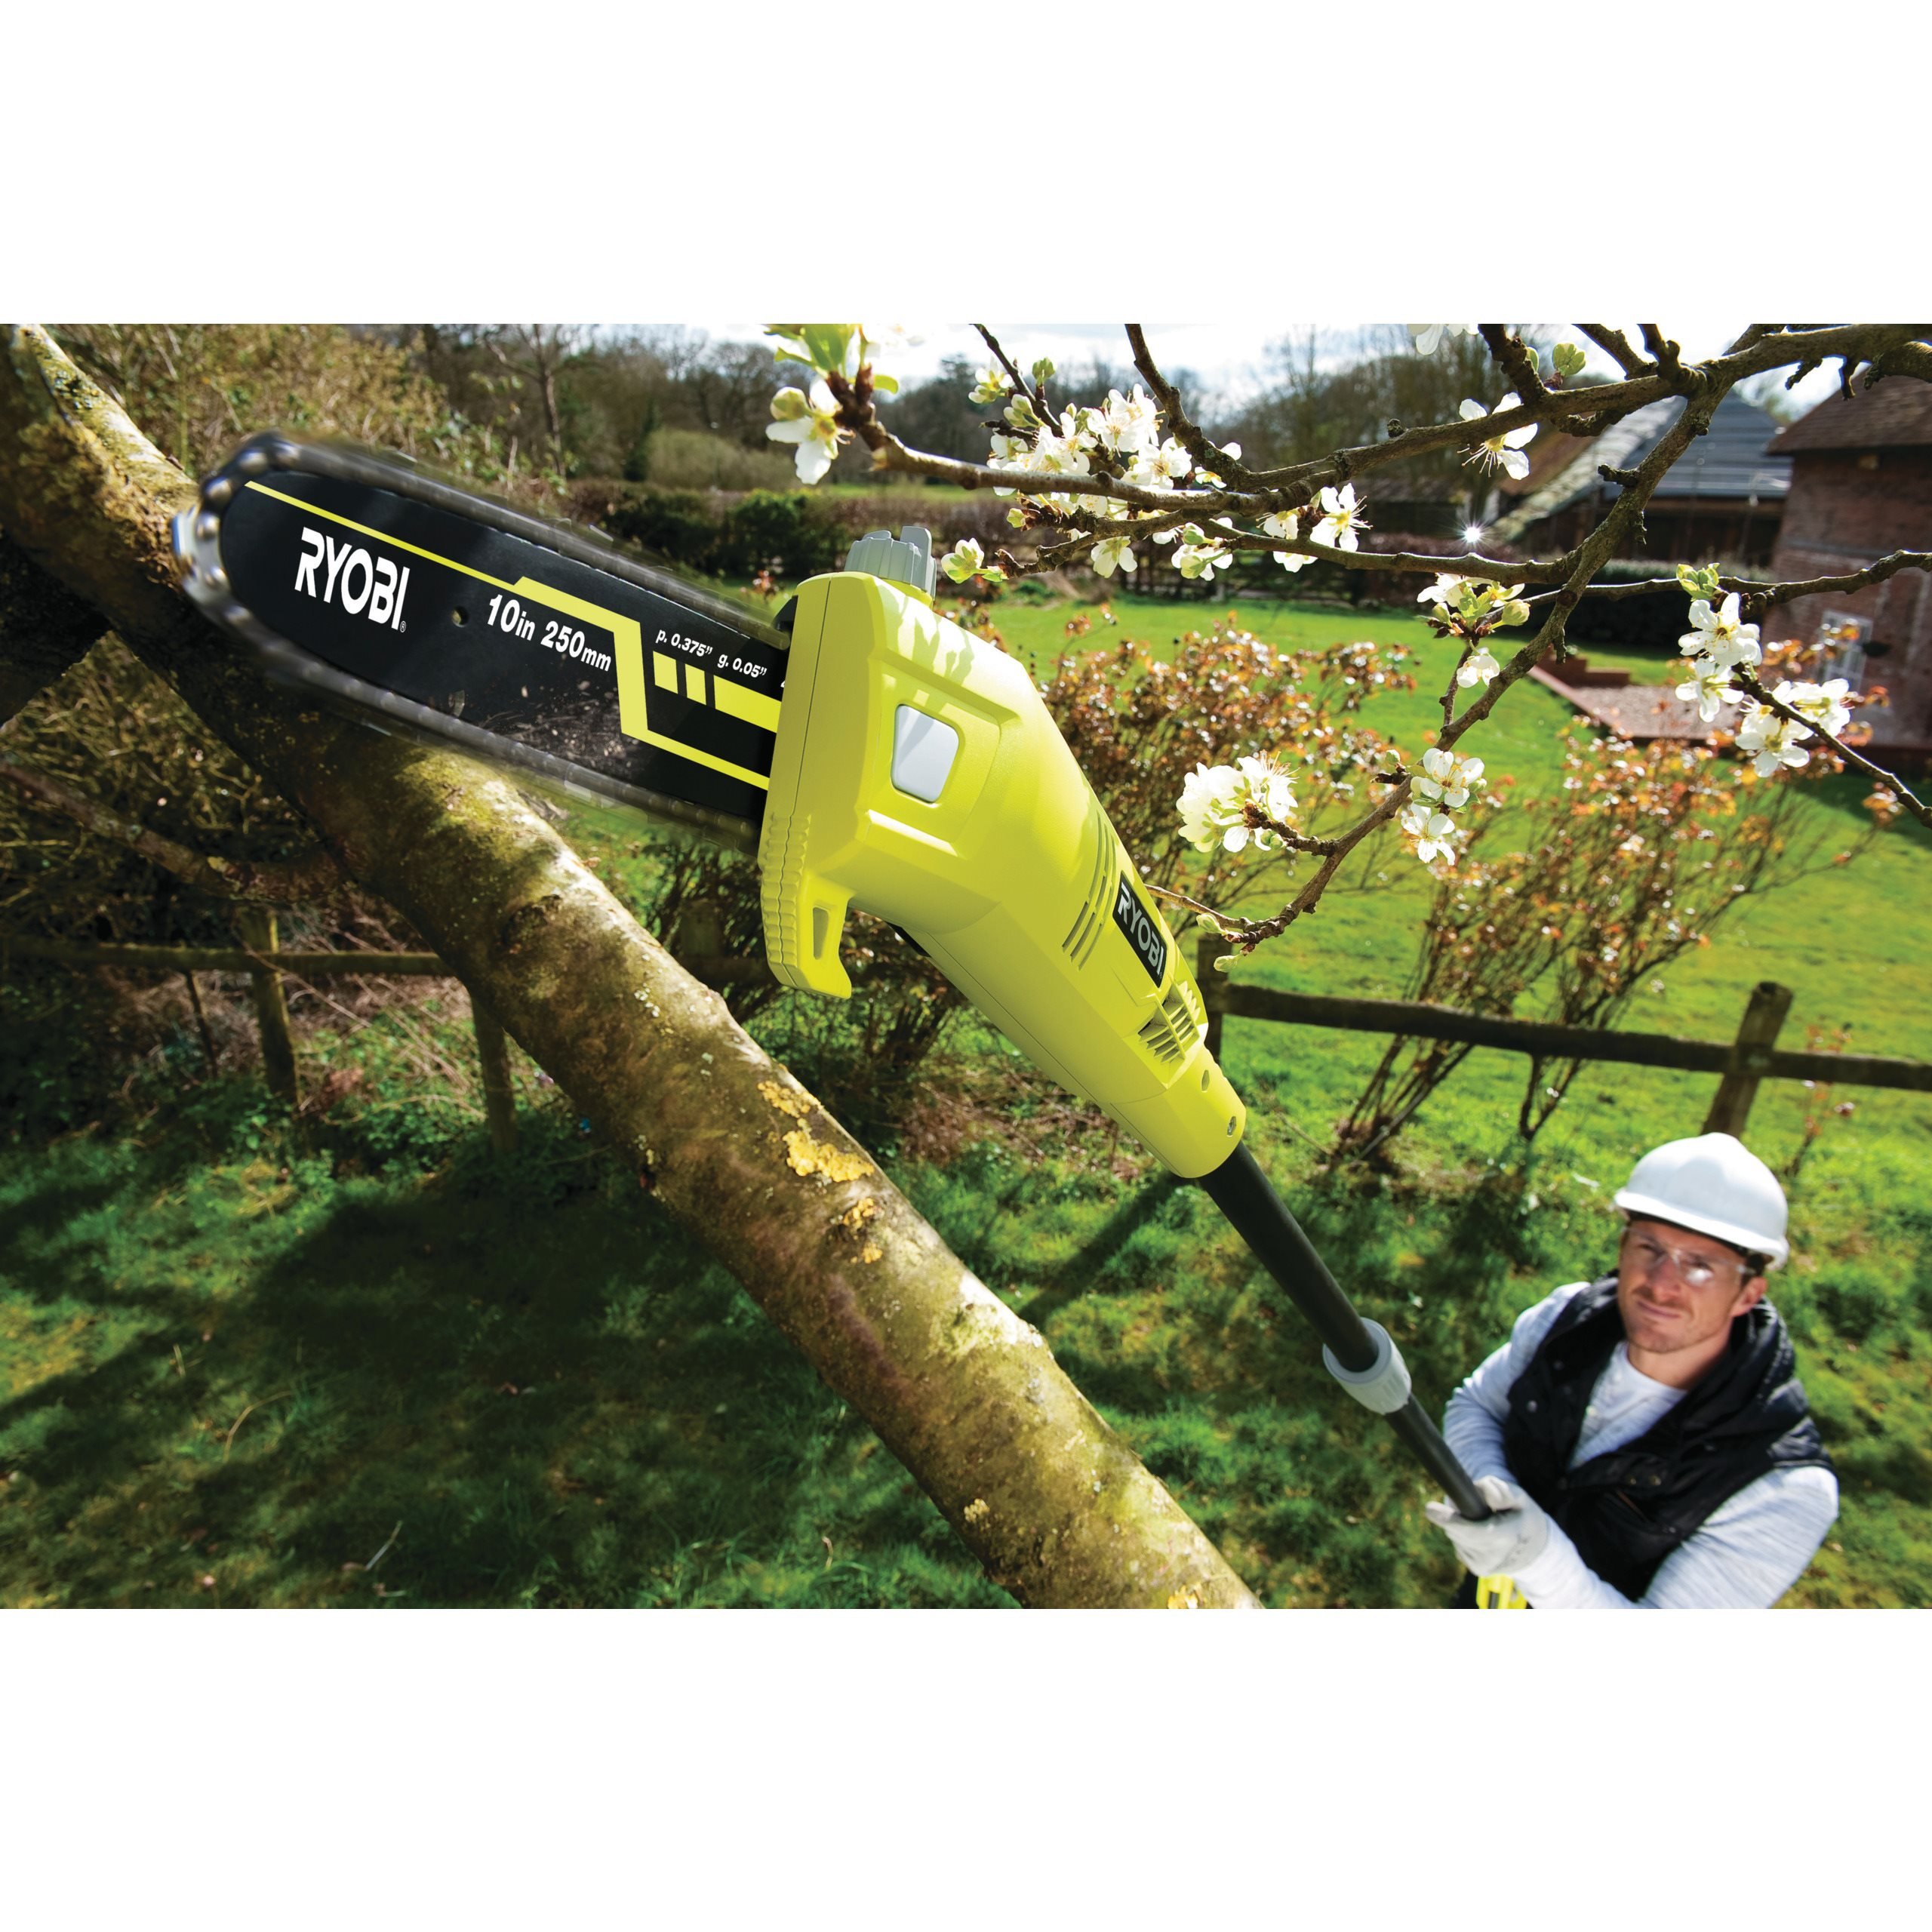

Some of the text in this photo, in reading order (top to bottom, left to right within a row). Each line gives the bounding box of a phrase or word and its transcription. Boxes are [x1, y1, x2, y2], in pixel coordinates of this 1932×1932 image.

[294, 527, 411, 631] RYOBI
[488, 594, 612, 672] 10in 250mm
[655, 629, 667, 644] p.
[717, 654, 729, 668] g.
[1117, 881, 1164, 976] RYOBI
